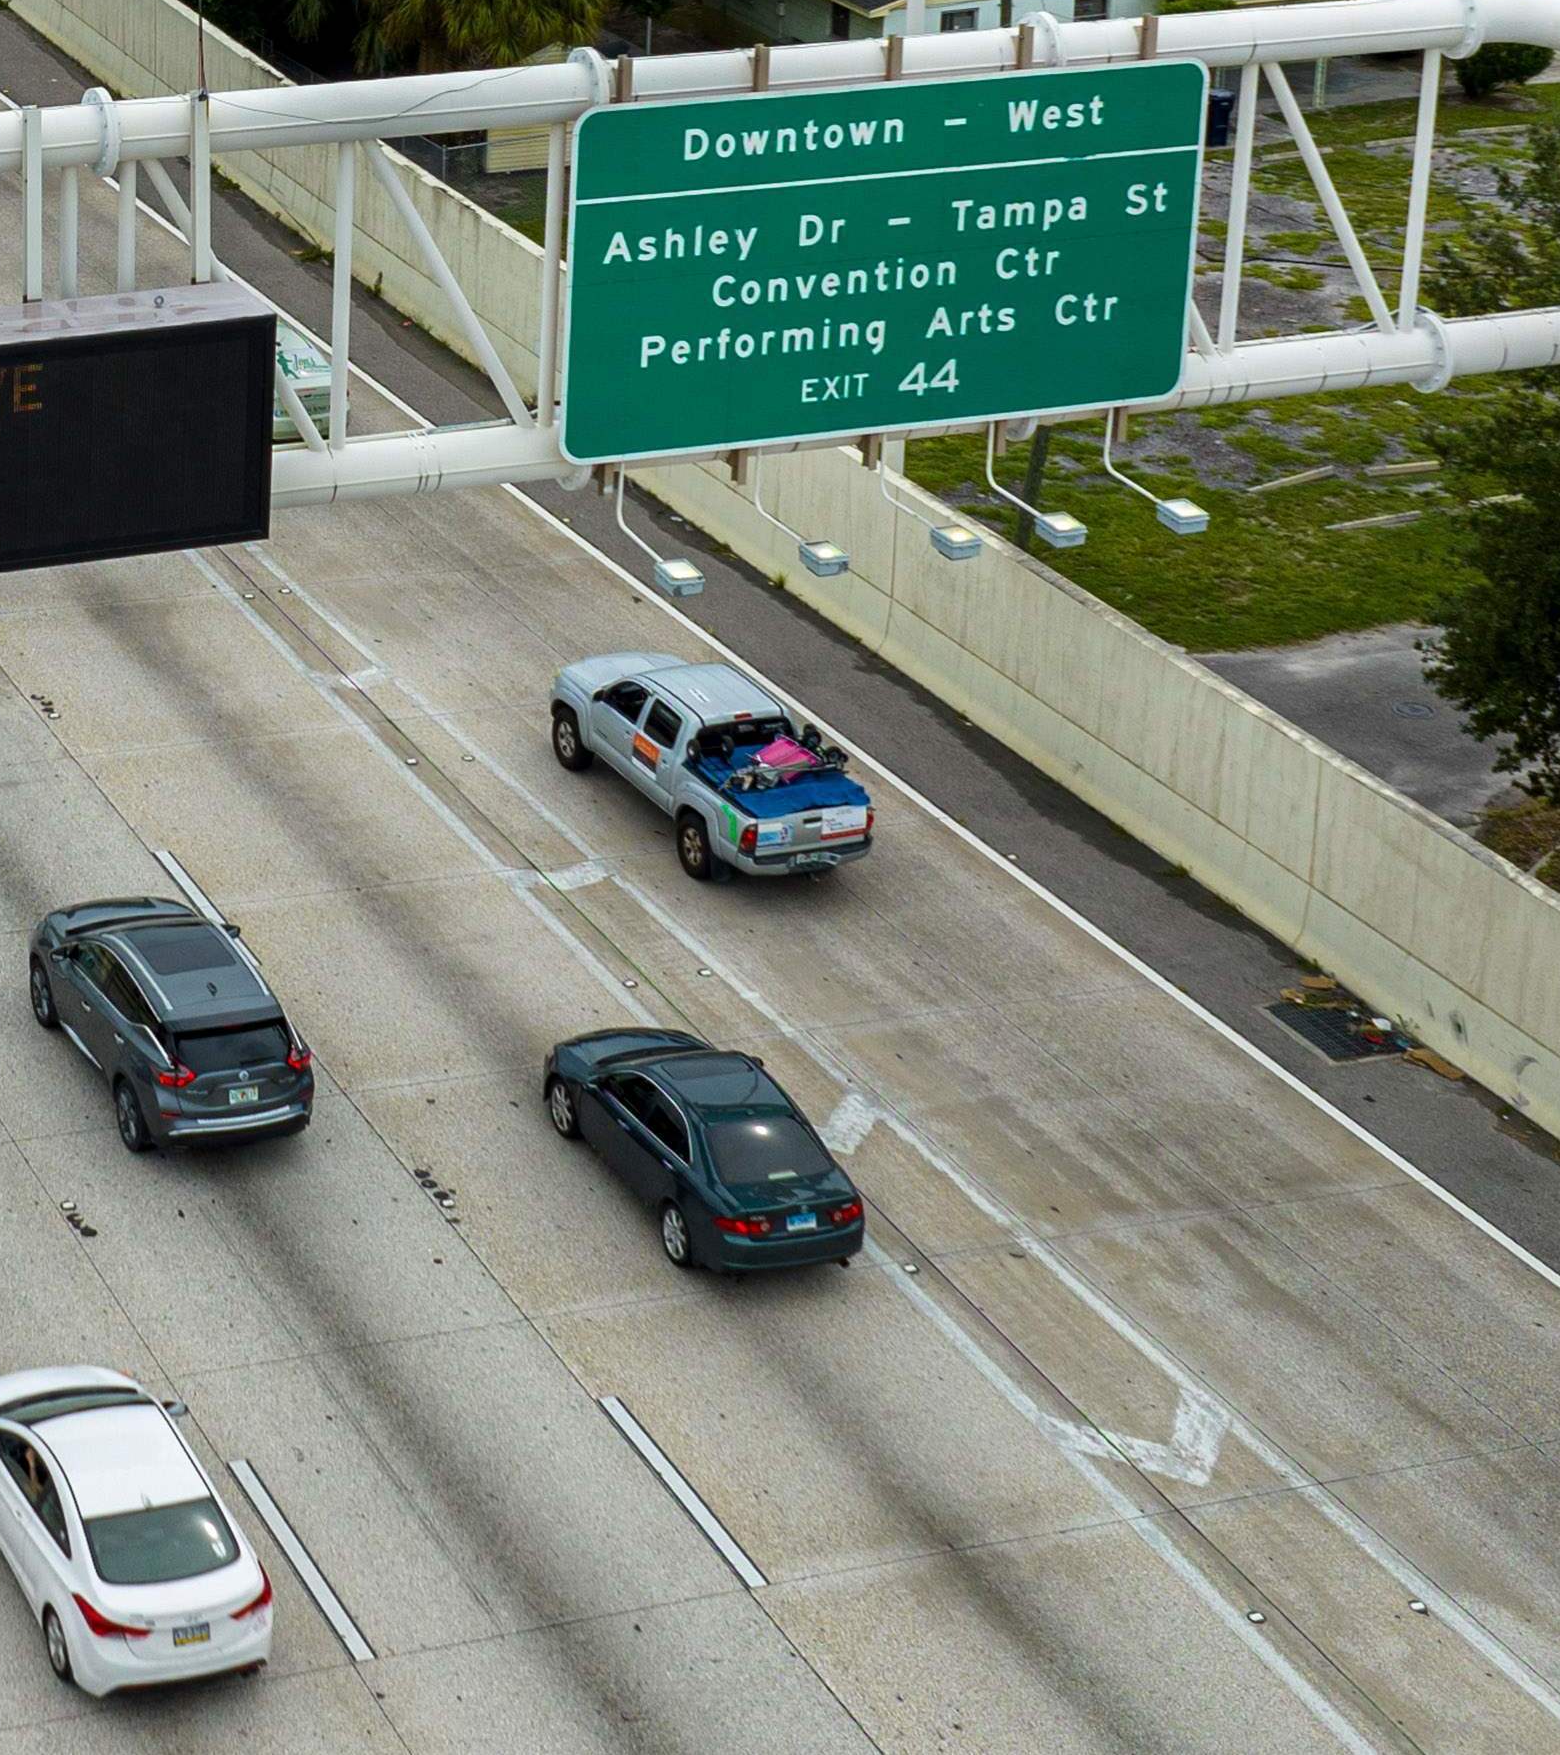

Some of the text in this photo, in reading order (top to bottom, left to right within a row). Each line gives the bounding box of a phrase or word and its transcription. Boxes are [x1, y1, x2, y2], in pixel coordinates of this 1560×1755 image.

[684, 118, 905, 160] Downtown
[1008, 95, 1105, 132] West
[603, 225, 758, 265] Ashley
[798, 214, 846, 248] Dr
[952, 197, 1088, 231] Tampa
[1126, 183, 1169, 216] St
[712, 248, 1061, 308] Convention Ctr
[640, 293, 1119, 368] Performing Arts Ctr
[801, 359, 961, 403] EXIT 44
